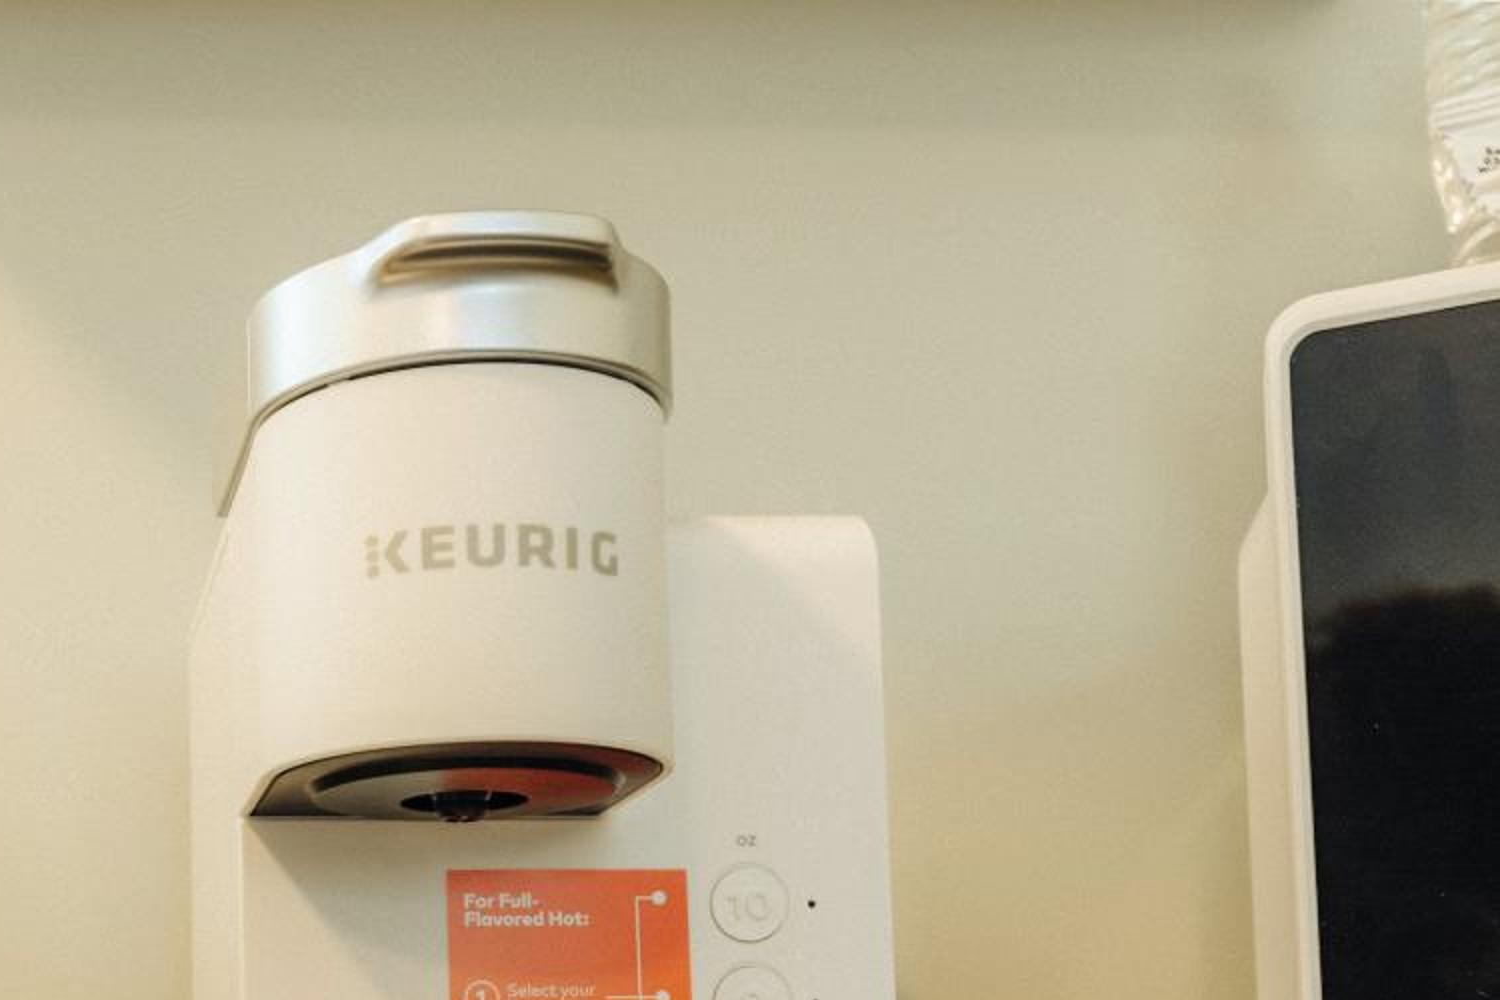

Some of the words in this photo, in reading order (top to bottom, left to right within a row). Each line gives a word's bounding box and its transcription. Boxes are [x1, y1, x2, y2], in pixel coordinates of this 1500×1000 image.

[366, 523, 618, 579] KEURIG
[463, 892, 495, 909] For
[499, 891, 539, 909] Full-
[727, 892, 770, 921] 10
[464, 911, 544, 927] Flavored
[548, 911, 590, 927] Hot:
[507, 982, 557, 998] Select
[560, 985, 596, 1000] your
